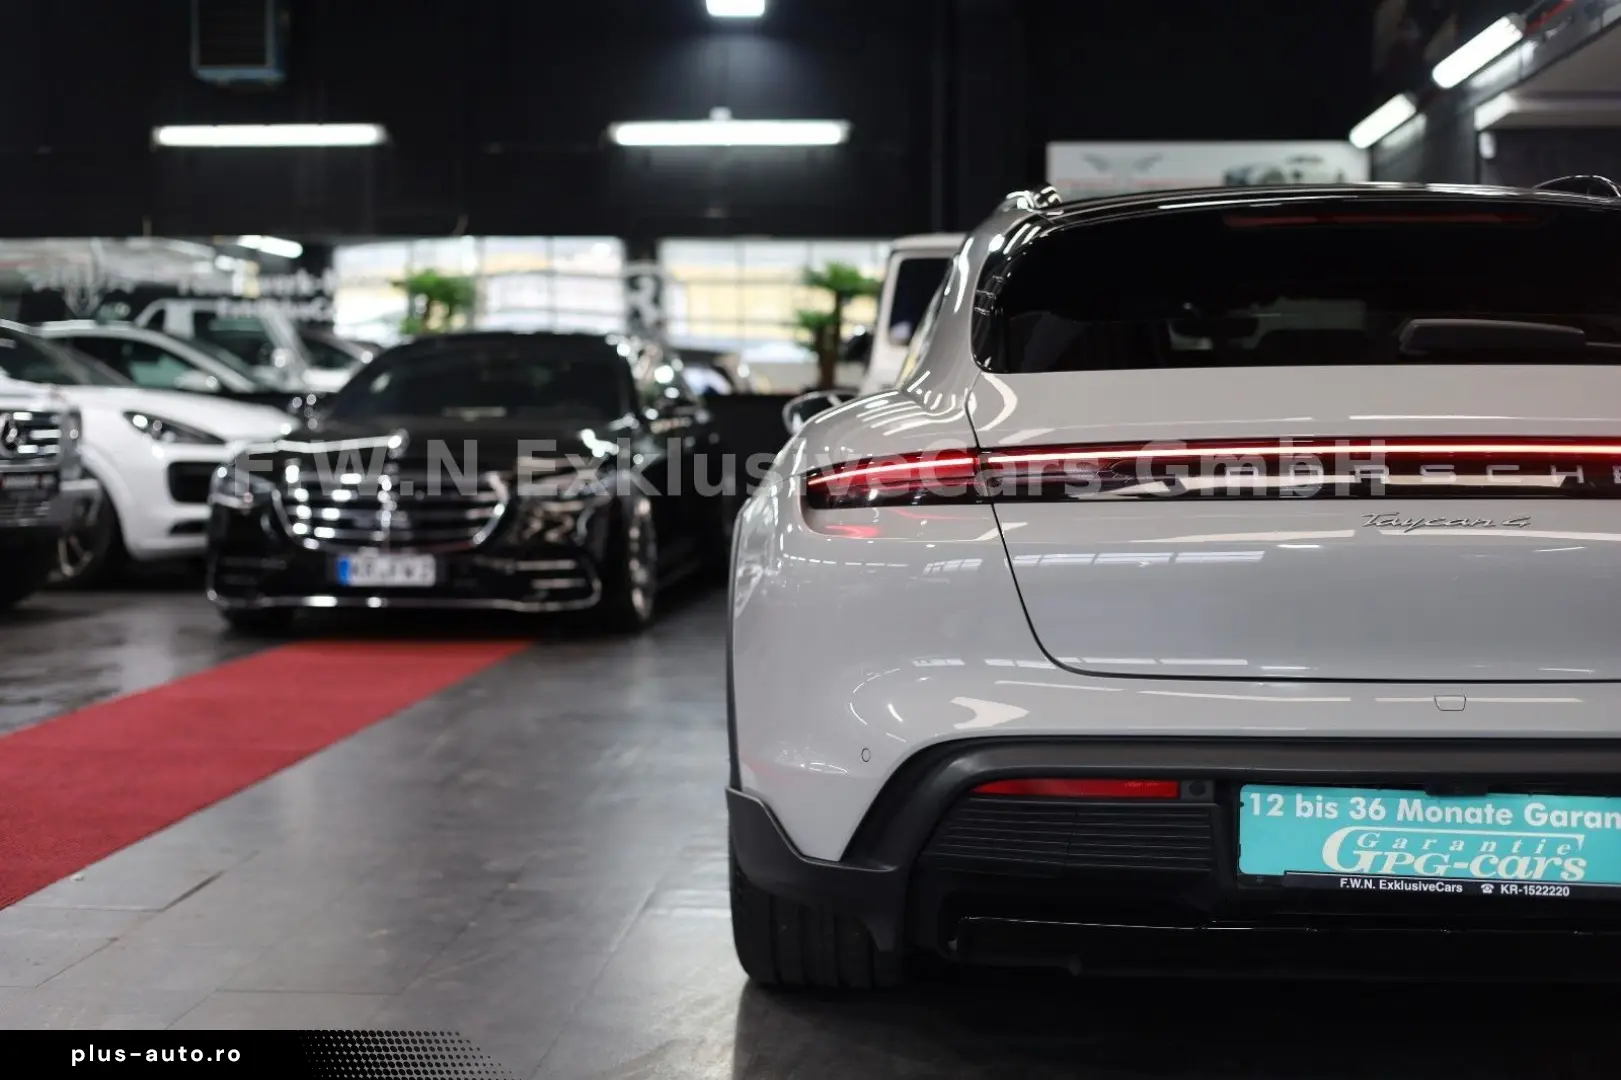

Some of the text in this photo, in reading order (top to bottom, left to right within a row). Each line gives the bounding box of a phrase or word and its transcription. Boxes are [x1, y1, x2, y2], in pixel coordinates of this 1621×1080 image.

[1361, 512, 1532, 533] Taycan 4
[1249, 793, 1284, 817] 12
[1295, 793, 1338, 819] bis
[1349, 796, 1386, 821] 36
[1396, 798, 1513, 826] Monate
[1322, 825, 1587, 881] GPG-cars
[1356, 831, 1572, 856] Garantie
[1340, 877, 1570, 897] F.W.N. ExklusiveCars KR-1522220
